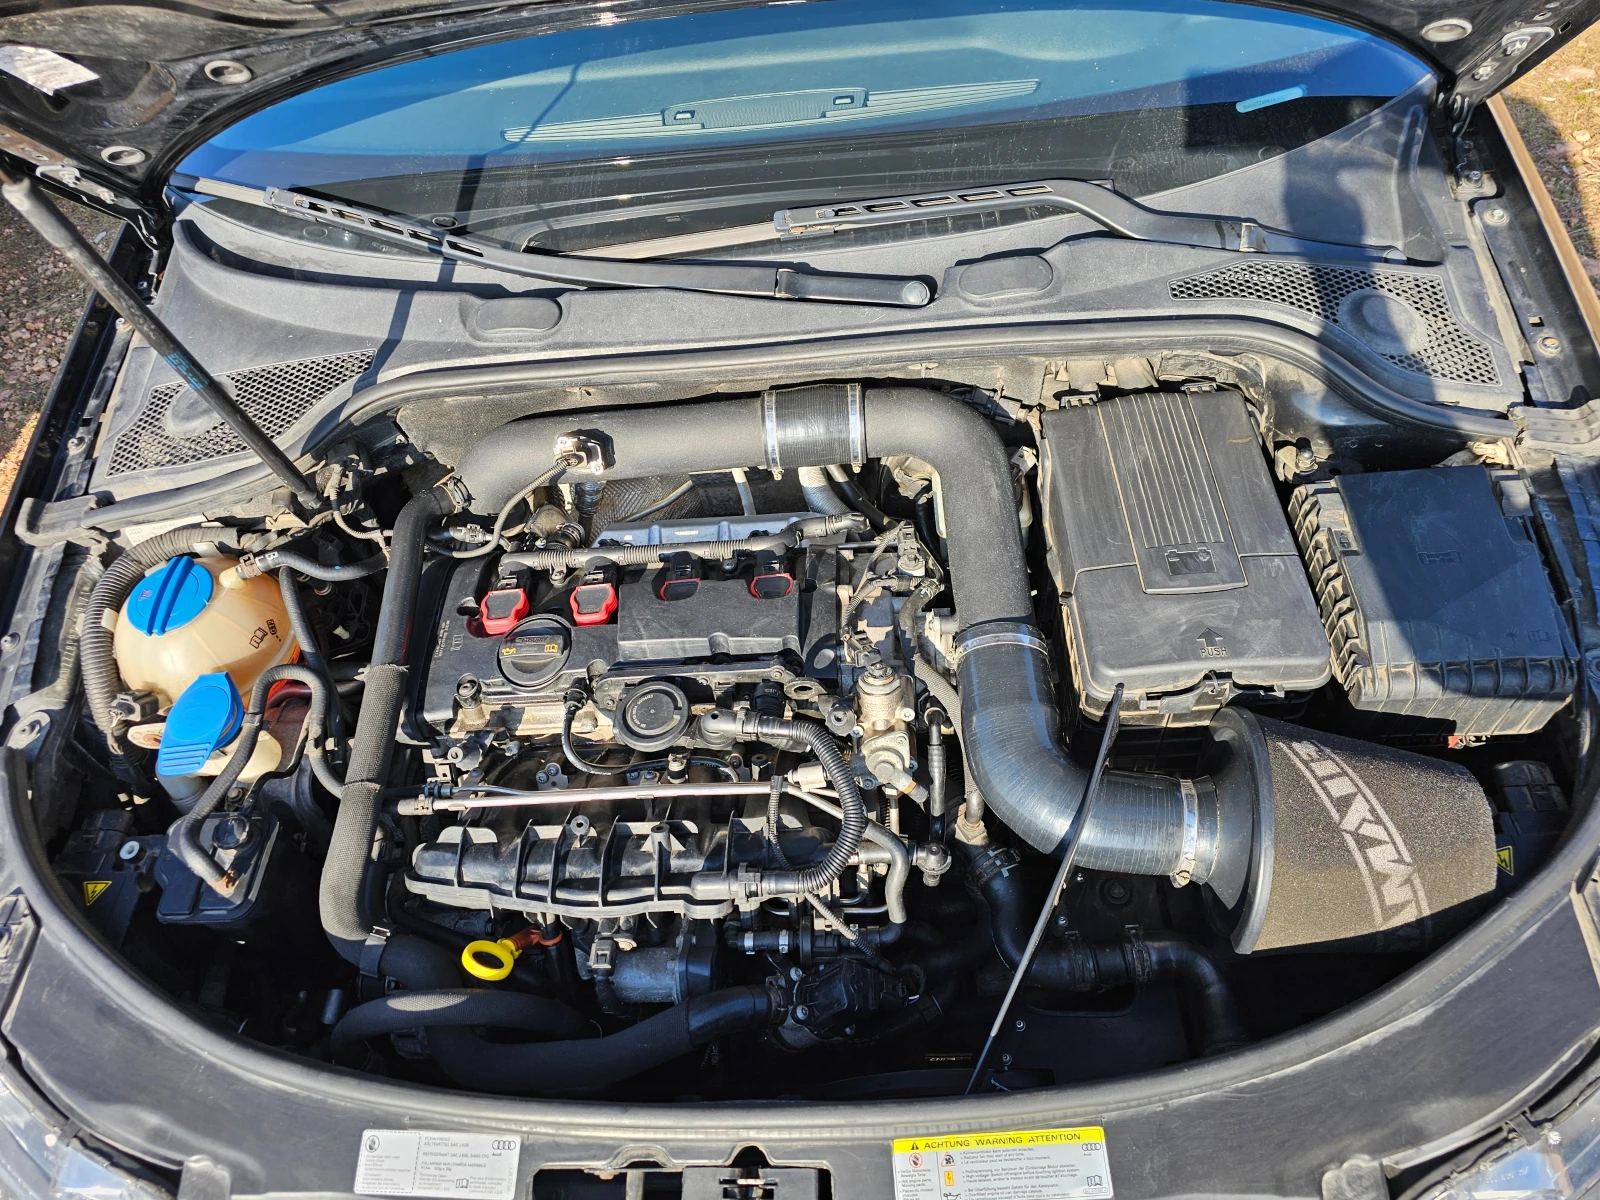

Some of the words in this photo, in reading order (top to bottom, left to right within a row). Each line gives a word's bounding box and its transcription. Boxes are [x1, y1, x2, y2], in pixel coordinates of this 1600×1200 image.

[1200, 646, 1228, 658] PUSH
[924, 1140, 970, 1150] ACHTUNG
[976, 1136, 1022, 1146] WARNING
[1028, 1133, 1081, 1142] ATTENTION
